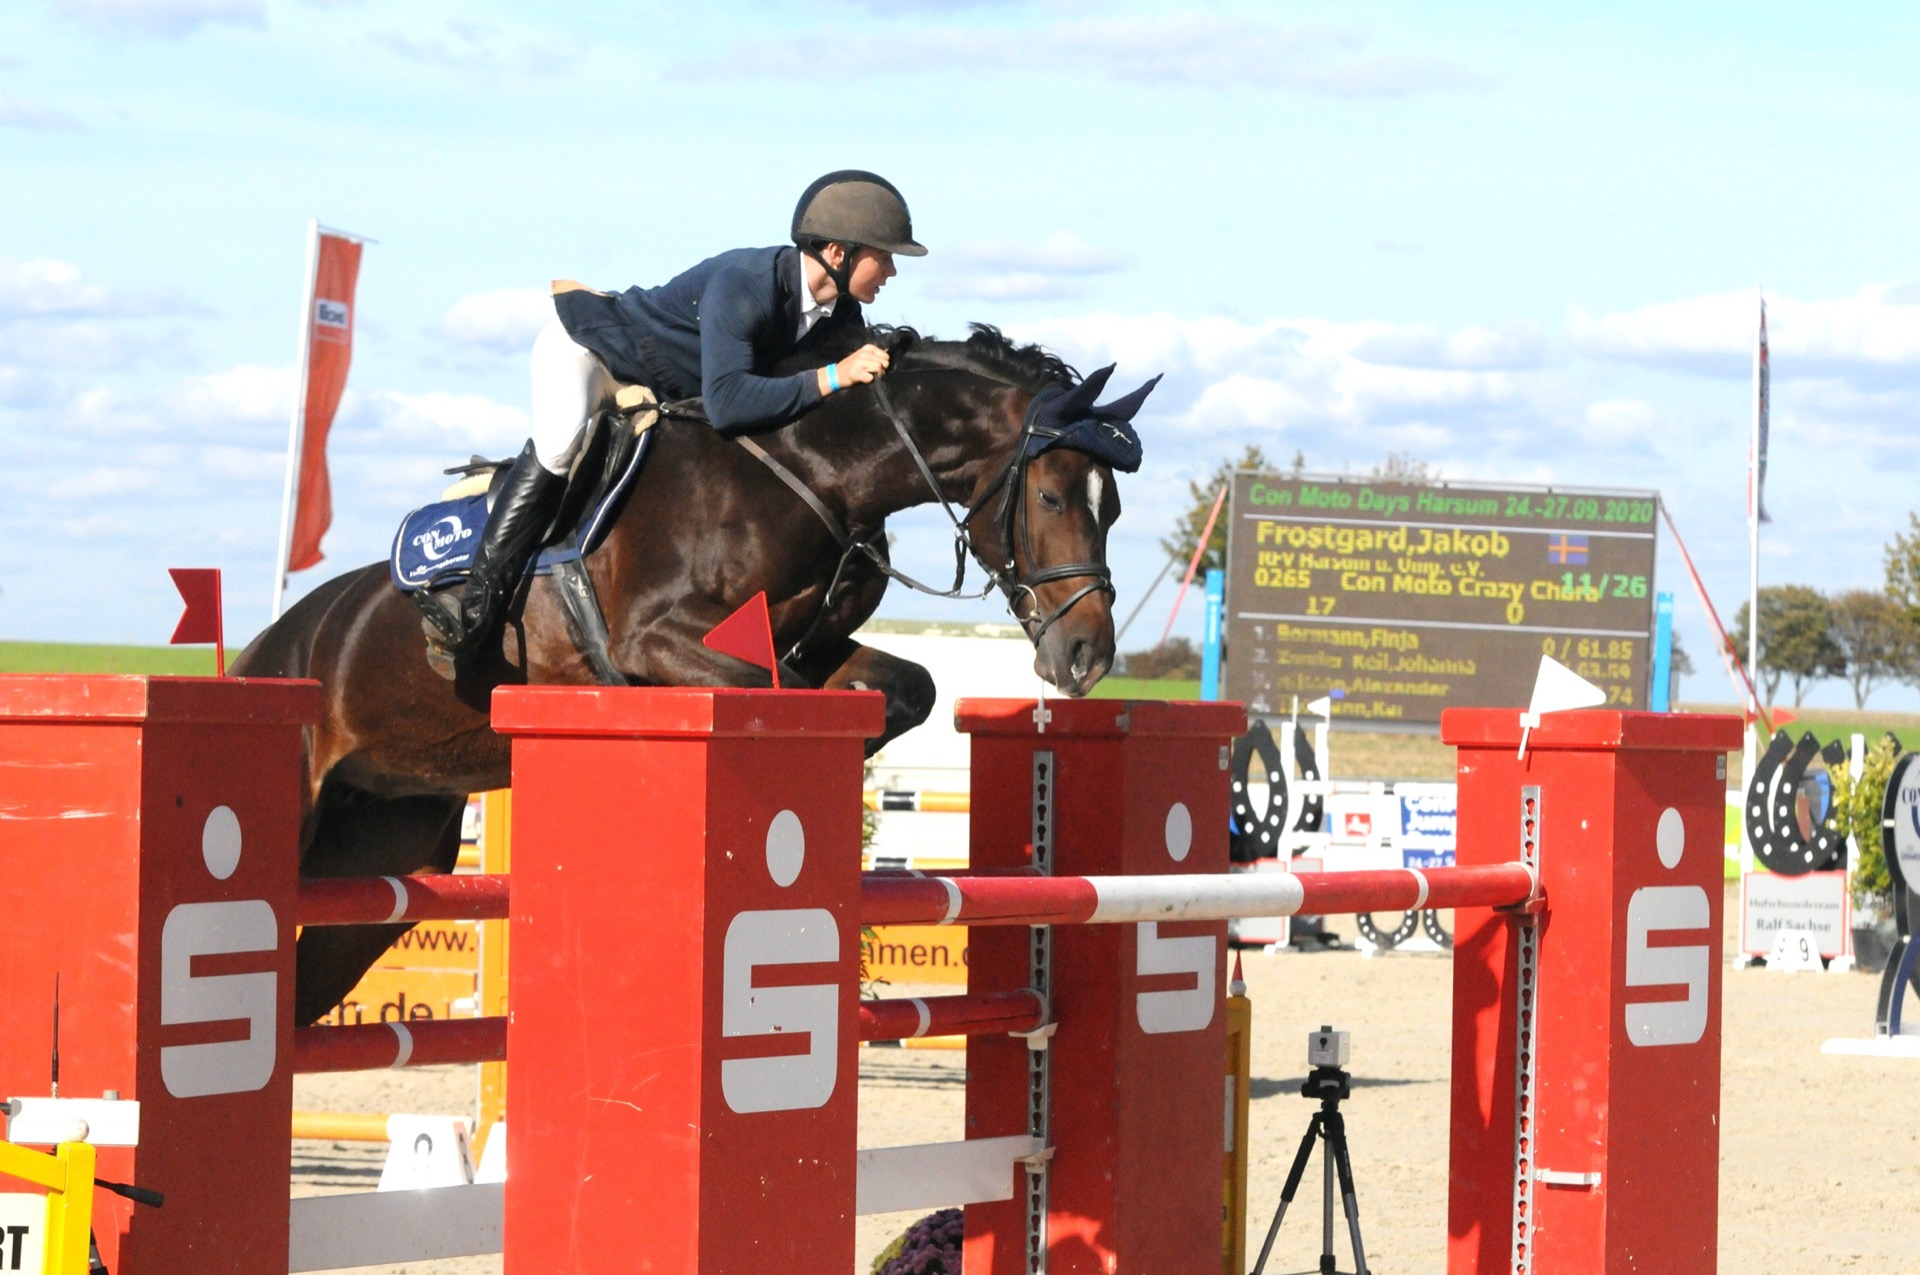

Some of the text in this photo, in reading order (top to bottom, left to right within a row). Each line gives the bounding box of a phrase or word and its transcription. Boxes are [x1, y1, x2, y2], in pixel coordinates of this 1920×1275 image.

[1250, 482, 1293, 507] Con
[1299, 484, 1352, 509] Moto
[1357, 487, 1411, 517] Days
[1416, 491, 1498, 515] Harsum
[1257, 521, 1510, 558] Frostgard,Jakob
[1254, 567, 1312, 589] 0265
[1341, 572, 1386, 593] Con
[1393, 574, 1453, 596] Moto
[1458, 577, 1525, 602] Crazy
[1305, 596, 1337, 616] 17
[1506, 601, 1525, 625] 0
